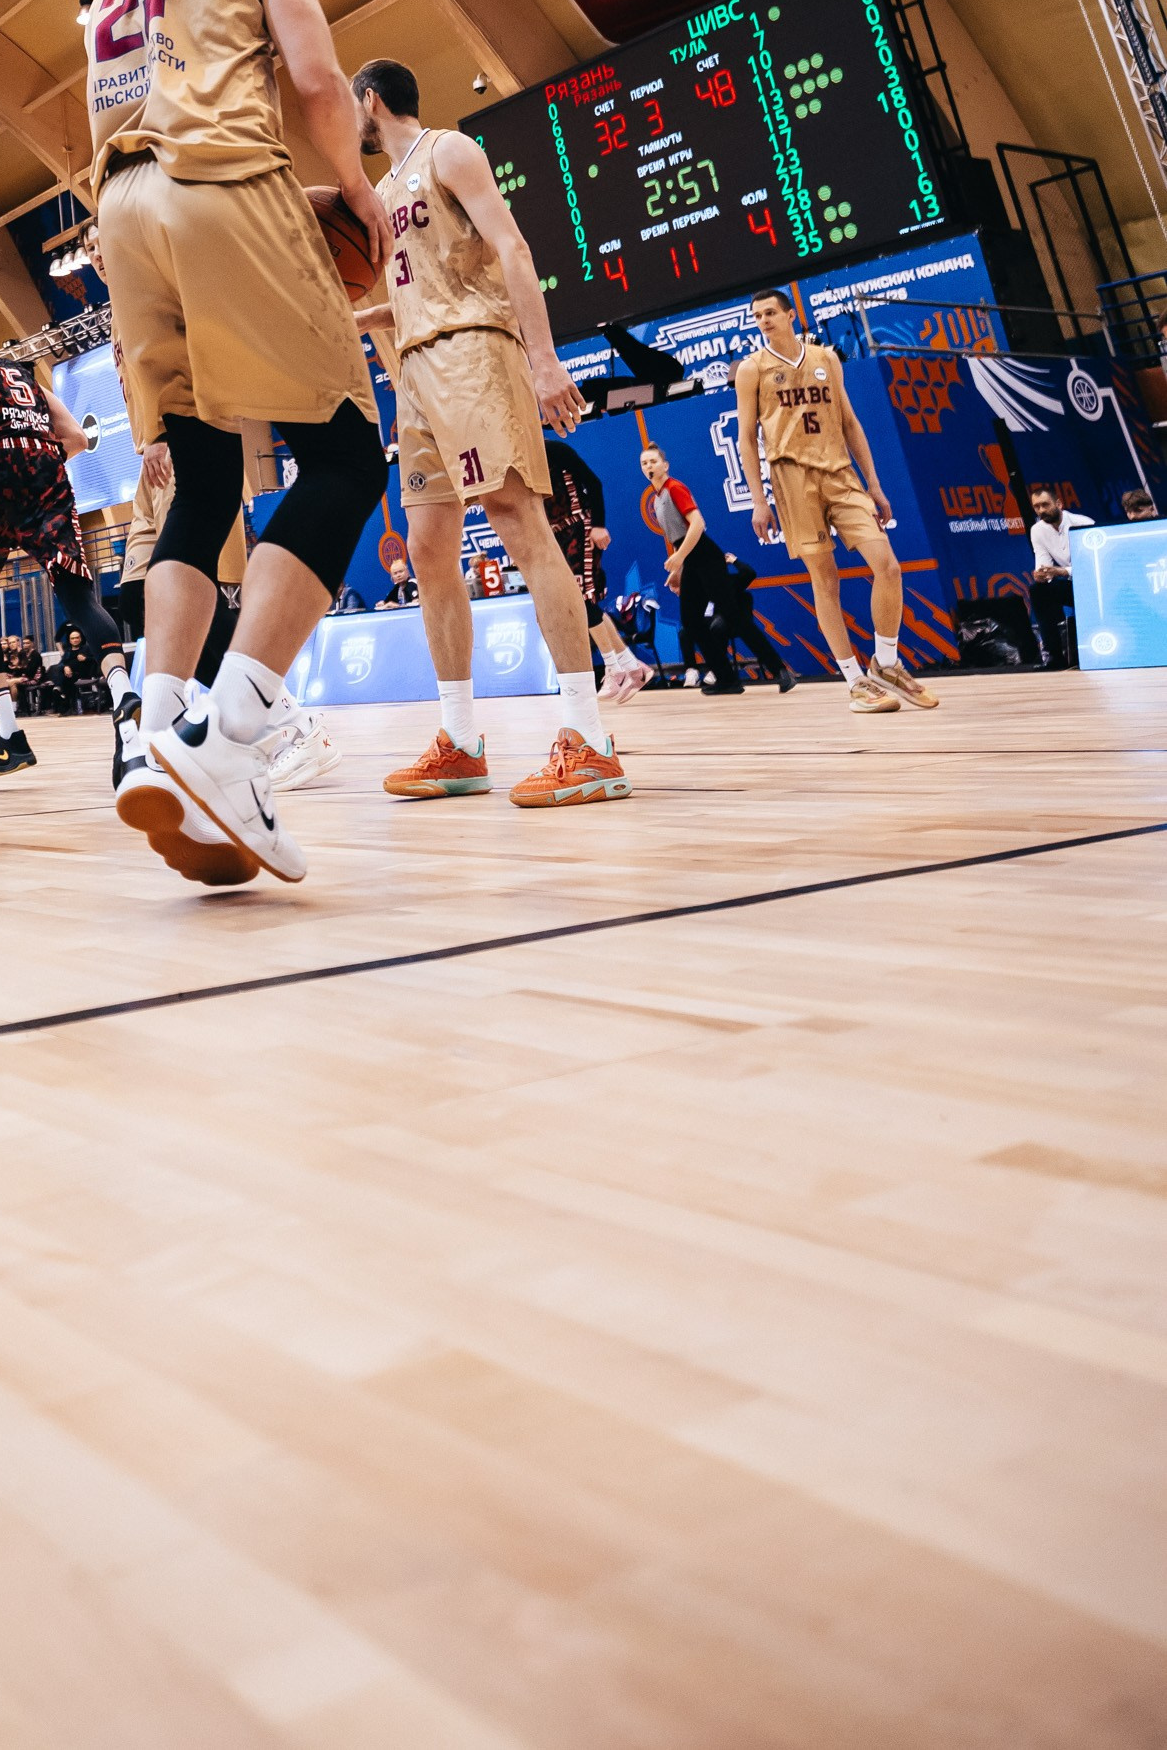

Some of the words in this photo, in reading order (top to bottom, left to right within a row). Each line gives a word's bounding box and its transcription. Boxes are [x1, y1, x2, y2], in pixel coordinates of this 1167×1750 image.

[749, 12, 761, 31] 1
[865, 4, 880, 26] 0
[753, 30, 765, 51] 7
[871, 25, 888, 48] 2
[669, 38, 707, 64] ТУЛА
[747, 50, 772, 75] 10
[878, 45, 893, 66] 0
[696, 53, 720, 73] СЧЕТ
[752, 69, 775, 94] 11
[884, 65, 900, 88] 3
[630, 78, 664, 101] ПЕРИОД
[695, 69, 736, 108] 48
[877, 86, 907, 114] 18
[548, 103, 558, 120] 0
[594, 99, 615, 117] СЧЕТ
[757, 88, 784, 114] 13
[552, 119, 562, 137] 6
[644, 99, 664, 136] 3
[763, 107, 789, 133] 15
[897, 107, 912, 130] 0
[555, 137, 566, 155] 8
[594, 113, 629, 156] 32
[768, 127, 792, 153] 17
[904, 129, 919, 152] 0
[559, 154, 569, 172] 0
[637, 158, 665, 179] ВРЕМЯ
[668, 148, 693, 167] ИГРЫ
[773, 148, 800, 175] 23
[911, 151, 924, 173] 1
[563, 172, 573, 190] 9
[644, 158, 719, 217] 2:57
[778, 167, 803, 196] 27
[918, 172, 933, 195] 6
[567, 190, 577, 208] 0
[741, 188, 768, 207] ФОЛЫ
[783, 188, 812, 215] 28
[909, 193, 940, 222] 13
[571, 207, 581, 226] 0
[640, 221, 670, 241] ВРЕМЯ
[672, 205, 720, 231] ПЕРЕРЫВА
[747, 207, 777, 247] 4
[789, 210, 815, 236] 31
[574, 225, 585, 244] 0
[795, 231, 823, 257] 35
[578, 243, 588, 262] 7
[599, 238, 622, 255] ФОЛЫ
[582, 262, 594, 281] 2
[670, 241, 700, 279] 11
[915, 253, 975, 279] КОМАНД
[603, 255, 629, 292] 4
[674, 324, 719, 342] ЧЕМПИОНАТ
[673, 337, 727, 366] ИНАЛ
[776, 386, 832, 408] ЦИВС
[802, 412, 820, 434] 15
[459, 447, 485, 487] 31
[939, 485, 1003, 517] ЦЕЛЬ
[484, 566, 500, 589] 5
